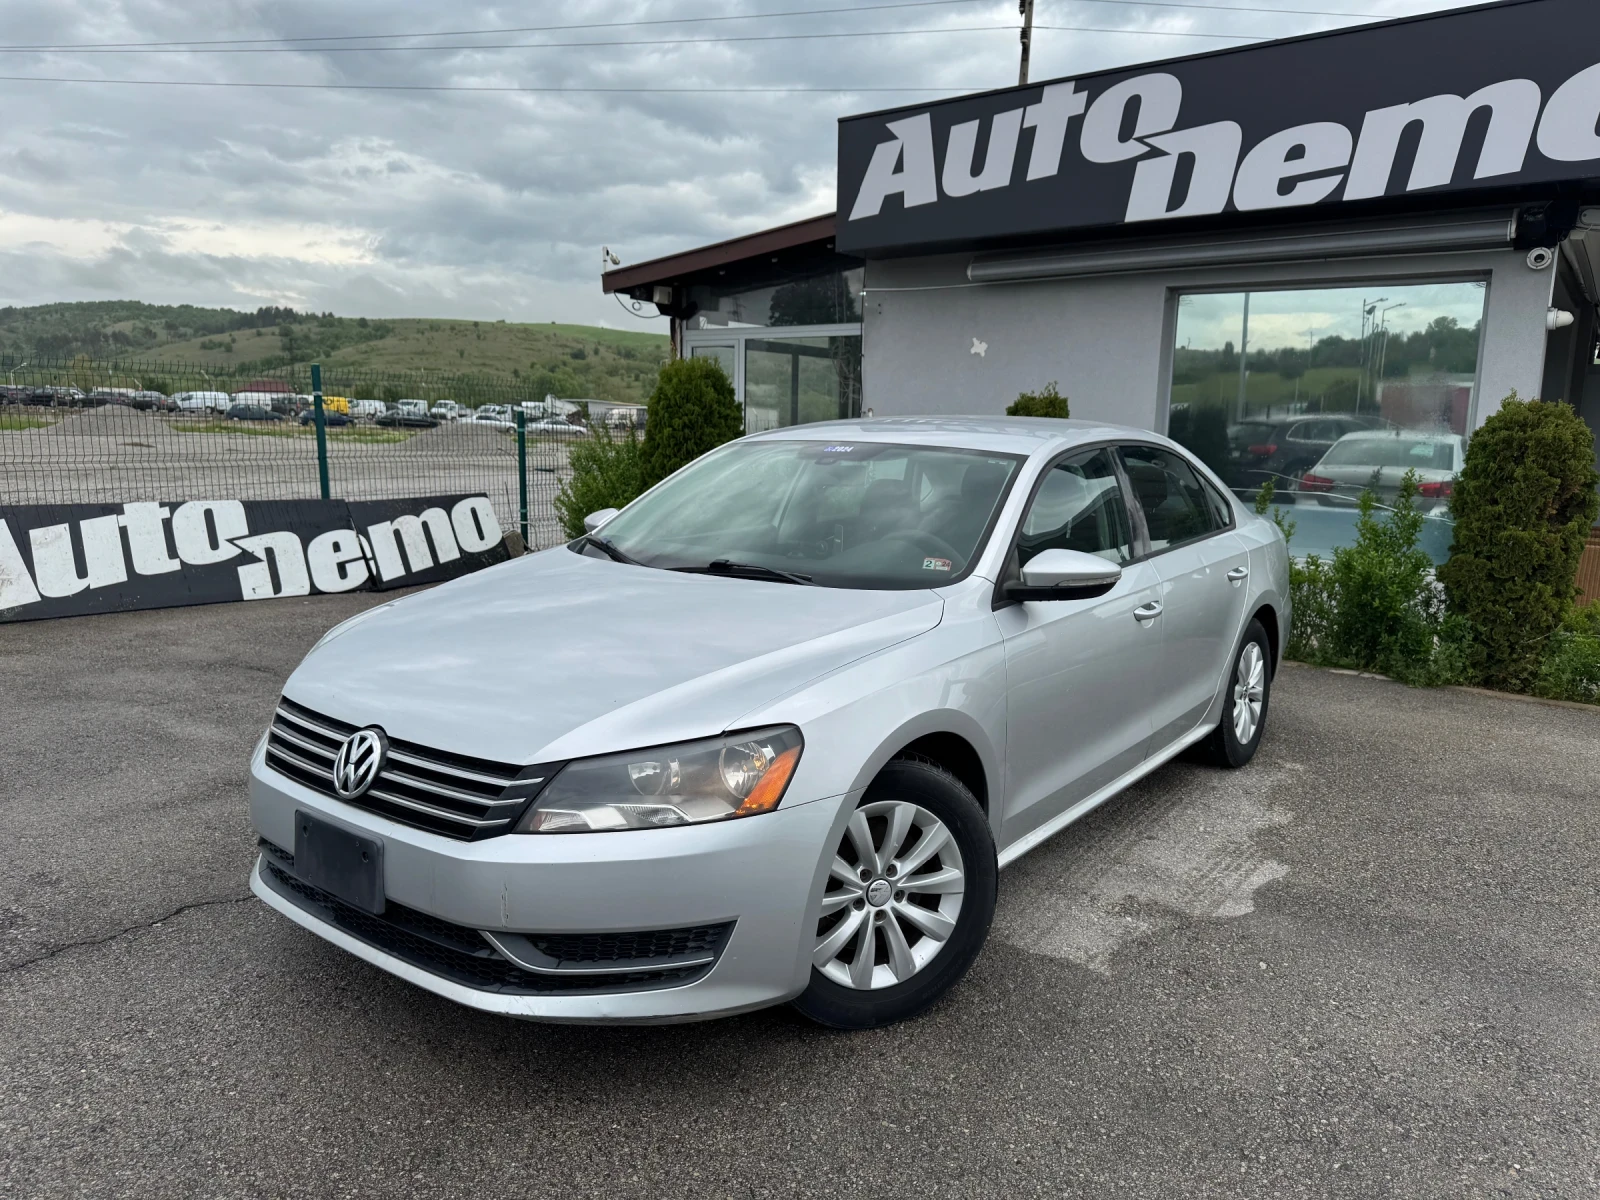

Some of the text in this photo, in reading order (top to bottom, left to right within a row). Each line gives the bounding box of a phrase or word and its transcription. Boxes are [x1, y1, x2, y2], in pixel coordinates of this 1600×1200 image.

[848, 72, 1183, 221] Auto
[237, 496, 503, 601] Demo
[924, 560, 933, 568] 2
[335, 732, 379, 797] VW
